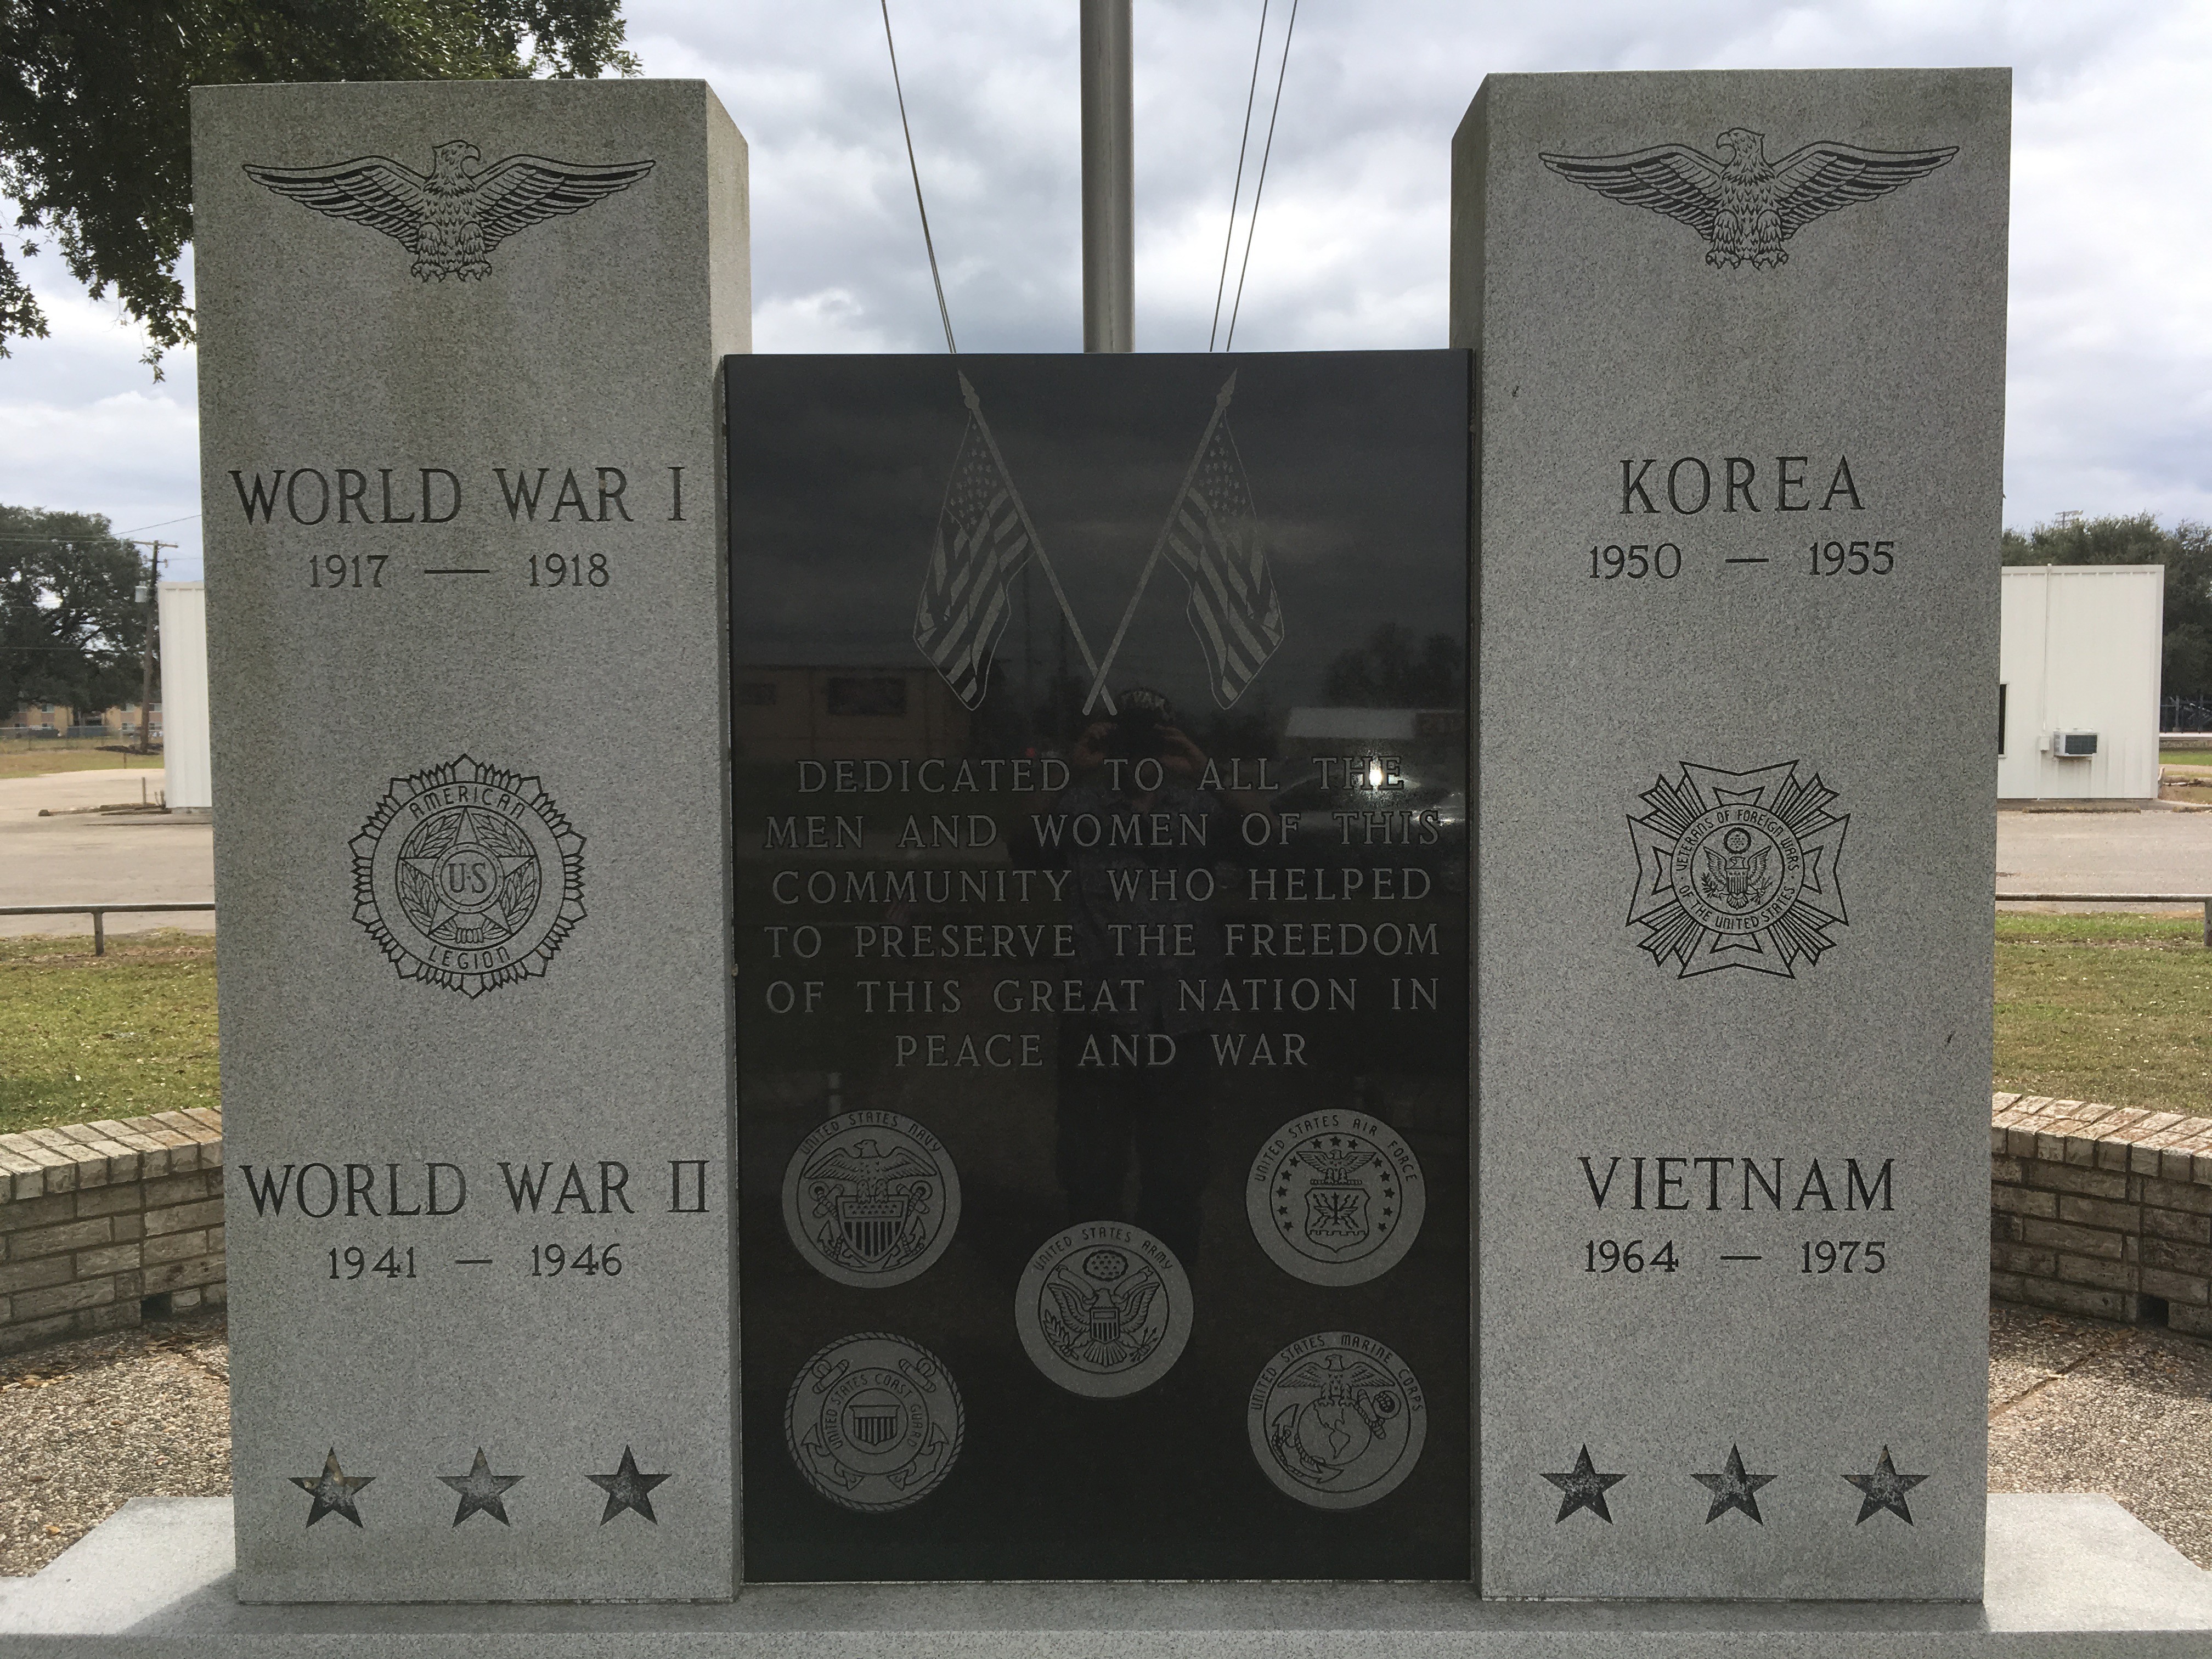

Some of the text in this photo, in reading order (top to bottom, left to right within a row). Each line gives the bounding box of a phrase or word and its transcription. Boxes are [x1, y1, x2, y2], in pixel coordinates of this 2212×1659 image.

[228, 467, 687, 526] WORLD WAR I
[1620, 455, 1866, 515] KOREA
[310, 554, 389, 589] 1917
[529, 552, 610, 588] 1918
[1589, 543, 1681, 579] 1950
[1809, 541, 1894, 575] 1955
[797, 755, 1404, 792] DEDICATED TO ALL THE
[409, 786, 526, 820] AMERICAN
[764, 810, 1440, 848] MEN AND WOMEN OF THIS
[1675, 809, 1799, 872] VETERANS OF FOREIGN WARS
[772, 867, 1431, 904] COMMUNITY WHO HELPED
[1679, 885, 1795, 929] OF THE UNITED STATES
[428, 945, 511, 970] LEGION
[764, 922, 1440, 959] TO PRESERVE THE FREEDOM
[766, 978, 1439, 1014] OF THIS GREAT NATION IN
[895, 1033, 1307, 1067] PEACE AND WAR
[800, 1111, 941, 1155] UNITED STATES NAVY
[1255, 1115, 1418, 1182] UNITED STATES AIR FORCE
[239, 1160, 710, 1218] WORLD WAR II
[1577, 1155, 1895, 1211] VIETNAM
[329, 1246, 417, 1280] 1941
[531, 1243, 623, 1277] 1946
[1033, 1227, 1173, 1271] UNITED STATES ARMY
[1584, 1239, 1679, 1273] 1964
[1801, 1240, 1886, 1274] 1975
[1251, 1334, 1424, 1412] UNITED STATES MARINE CORPS
[825, 1373, 923, 1450] UNITED STATES COAST GUARD
